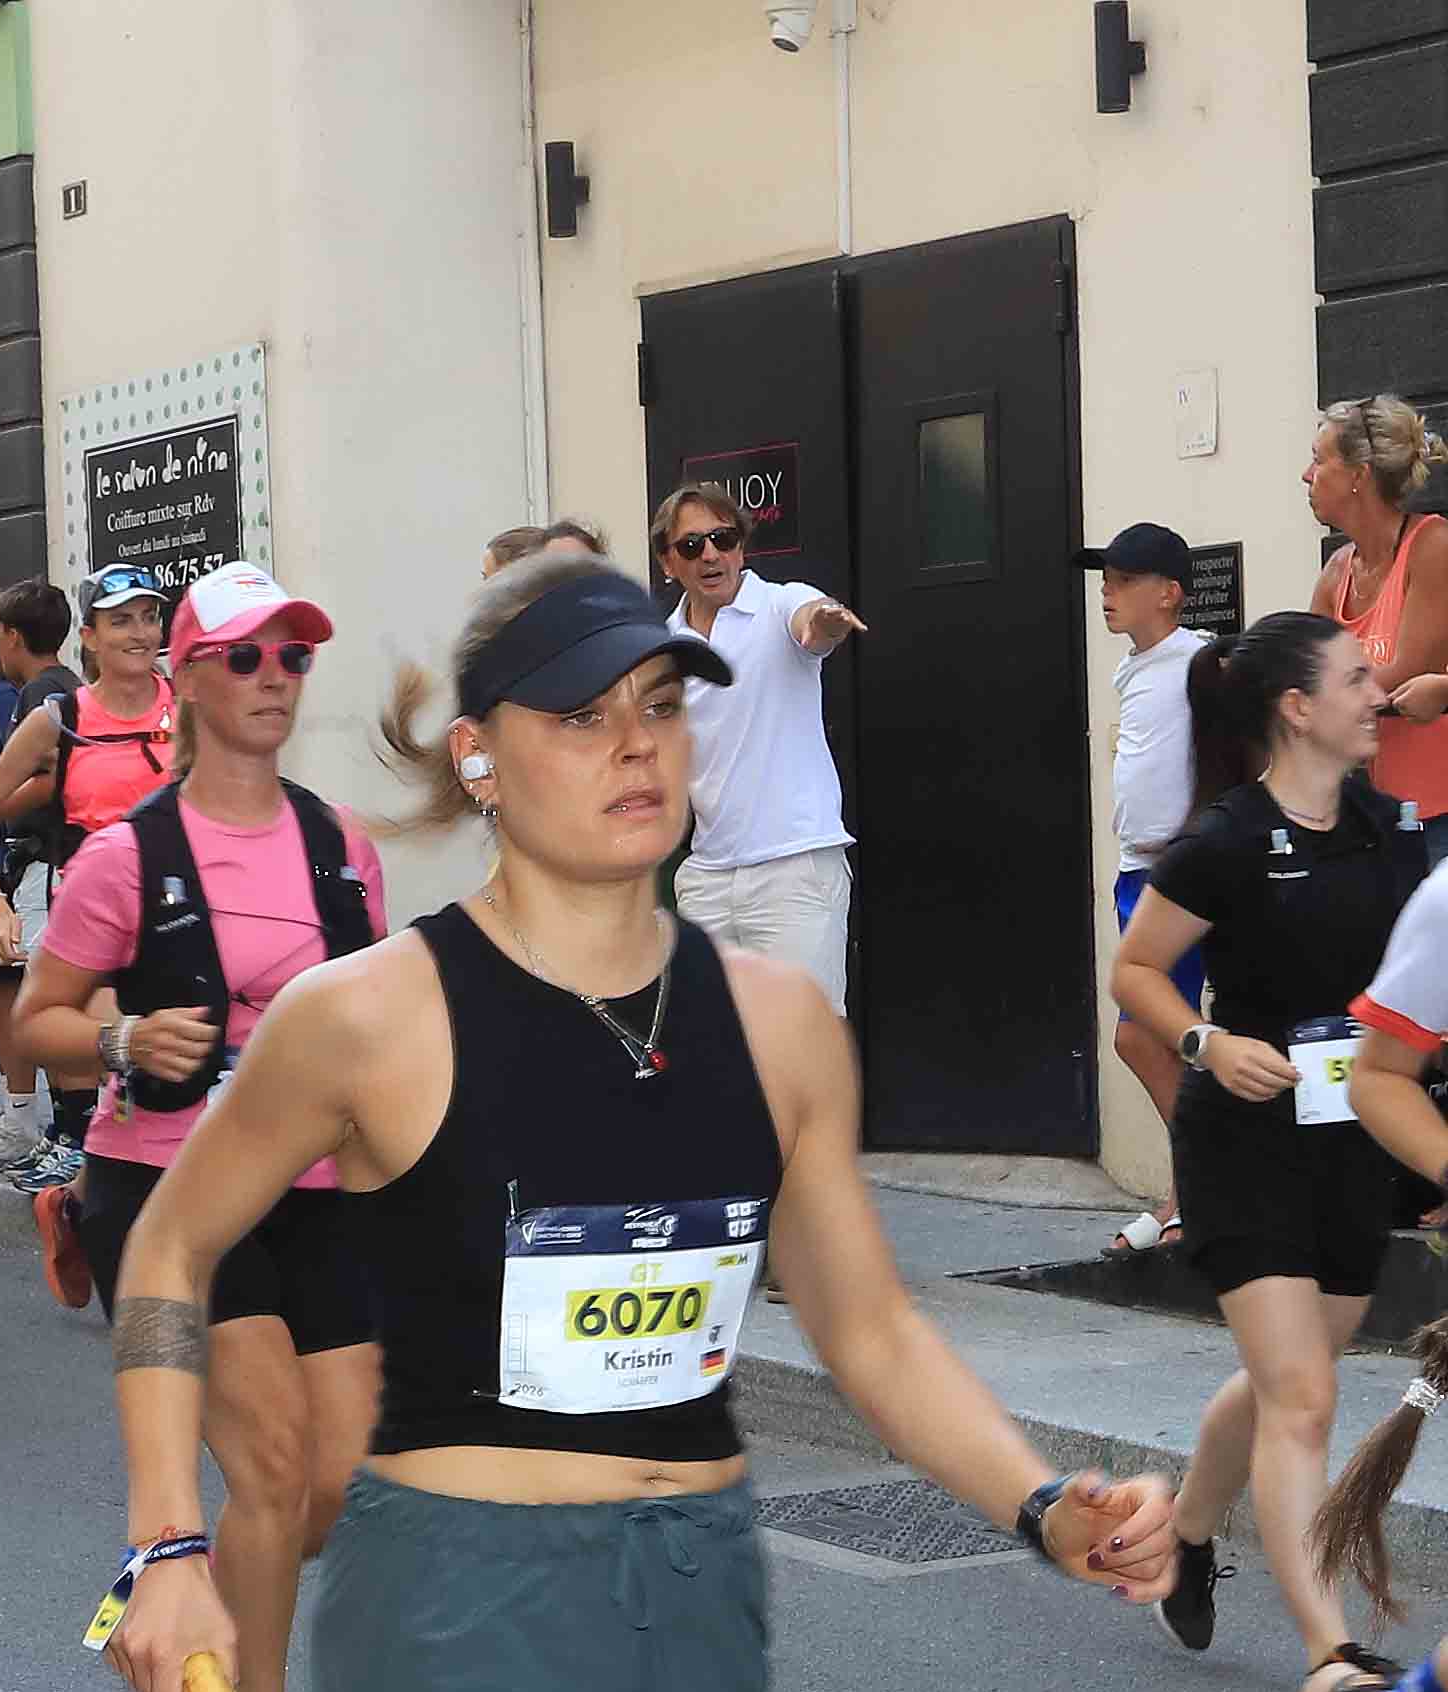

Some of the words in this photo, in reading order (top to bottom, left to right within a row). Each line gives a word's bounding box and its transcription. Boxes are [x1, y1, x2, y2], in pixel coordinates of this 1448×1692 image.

[162, 443, 182, 483] de
[187, 436, 228, 478] nina
[107, 508, 146, 533] Coiffure
[148, 503, 175, 525] mixte
[177, 501, 193, 519] sur
[194, 493, 216, 516] Rdv
[574, 1287, 703, 1337] 6070
[603, 1347, 673, 1371] Kristin
